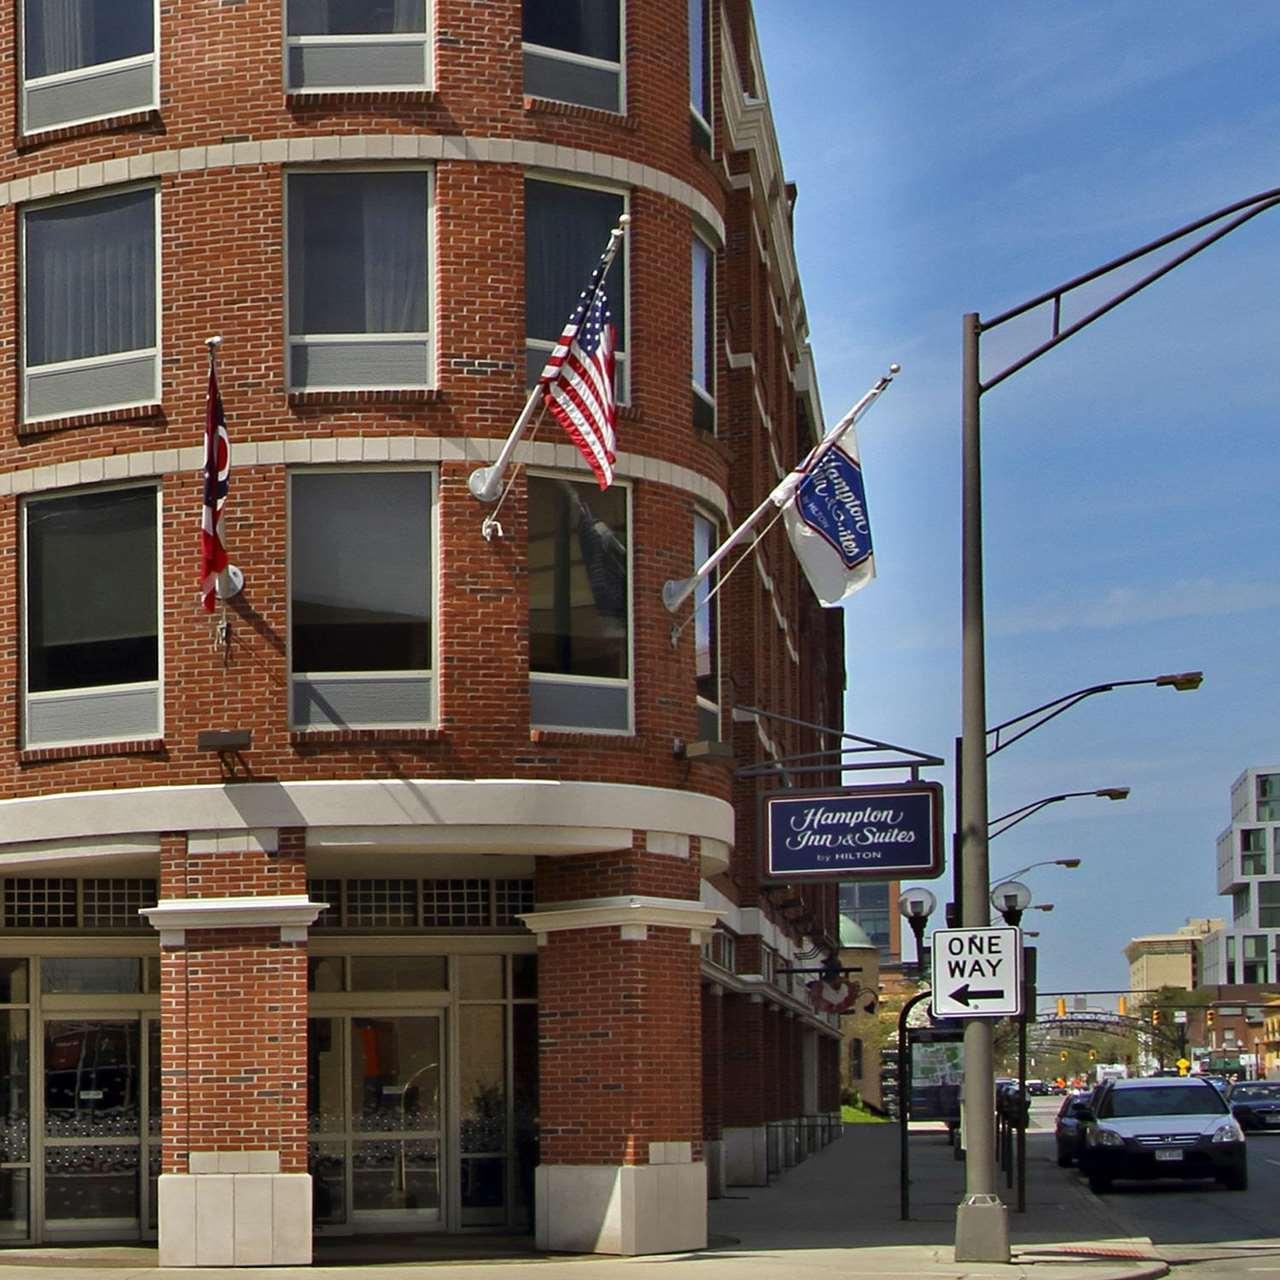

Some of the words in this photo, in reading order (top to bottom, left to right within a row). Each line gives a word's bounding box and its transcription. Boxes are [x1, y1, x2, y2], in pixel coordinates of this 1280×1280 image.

[790, 806, 904, 832] Hampton
[785, 830, 842, 851] Inn
[842, 833, 856, 848] &
[854, 826, 916, 846] Suites
[835, 851, 882, 861] HILTON
[948, 935, 1002, 956] ONE
[948, 958, 1003, 979] WAY
